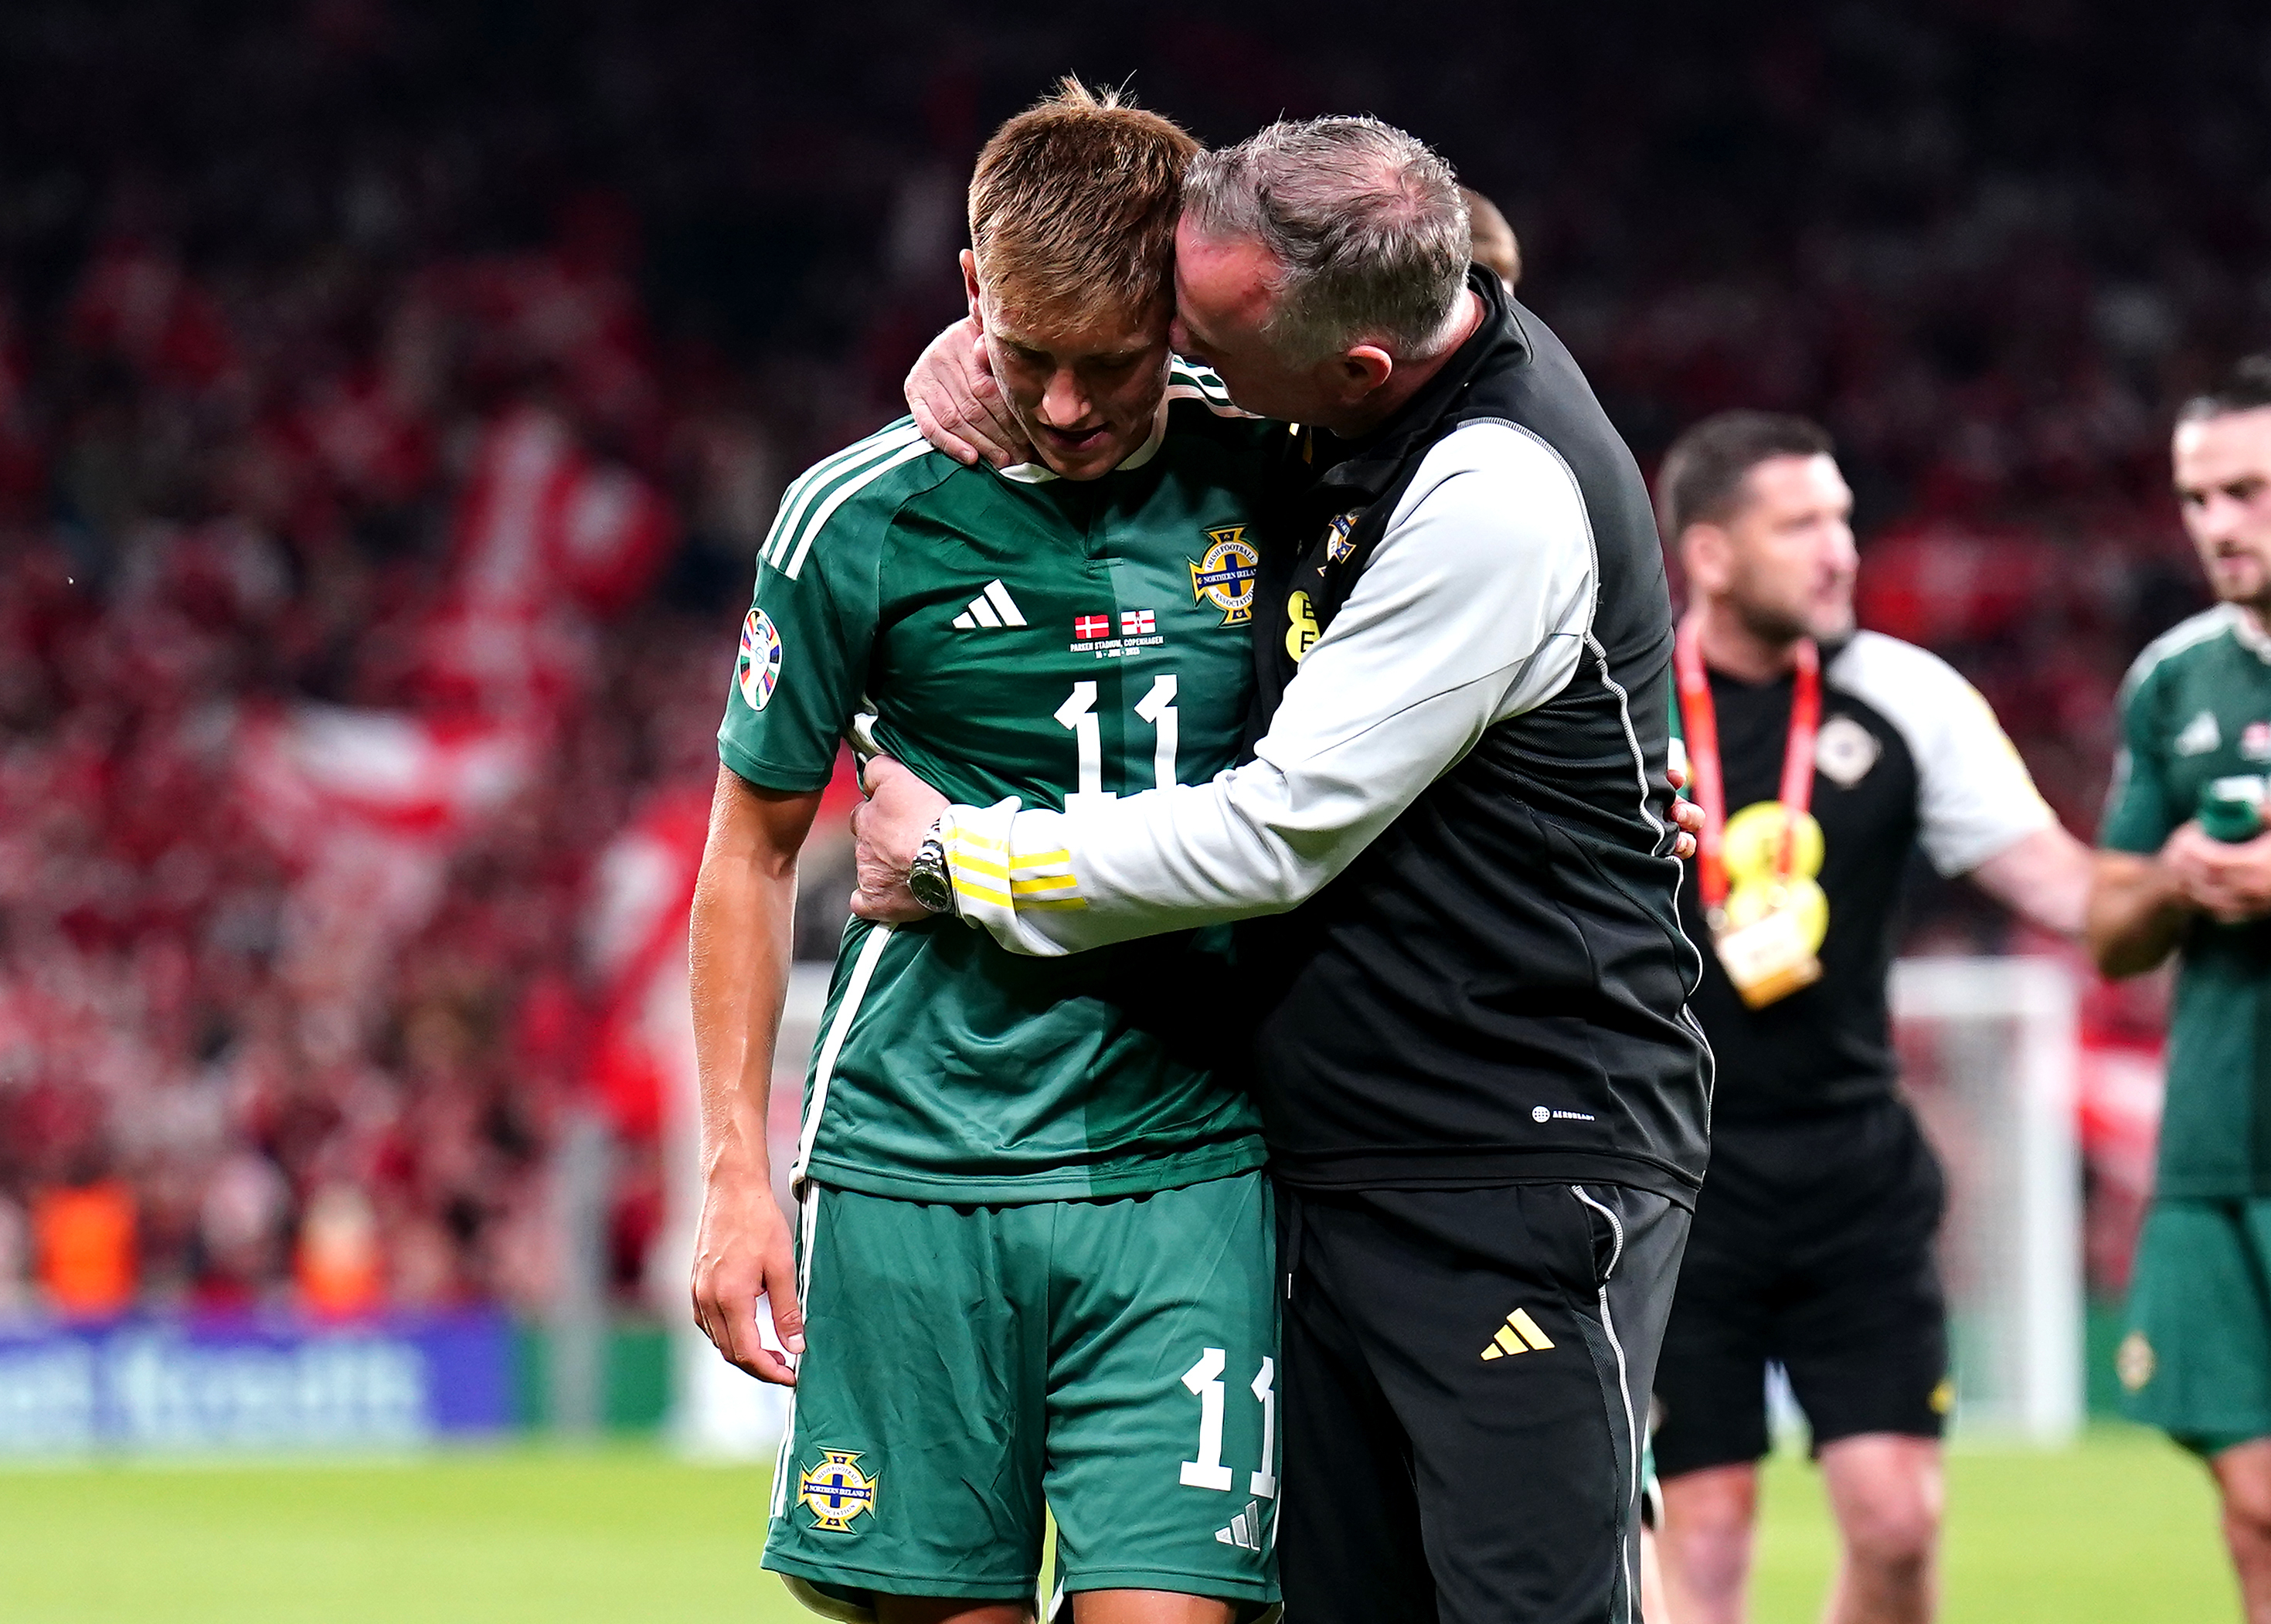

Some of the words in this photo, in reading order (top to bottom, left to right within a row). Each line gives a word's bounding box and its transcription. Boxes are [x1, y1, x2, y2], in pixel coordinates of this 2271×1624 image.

[1207, 548, 1222, 569] IRISH
[1221, 544, 1254, 562] FOOTBALL
[1203, 572, 1236, 583] NORTHERN
[1236, 569, 1256, 579] IRELA
[1070, 642, 1093, 652] PARKEN
[1094, 640, 1123, 650] STADIUM,
[1124, 636, 1164, 647] COPENHAGEN
[1052, 674, 1178, 810] 11
[1179, 1347, 1275, 1499] 11
[815, 1467, 831, 1480] IRISH
[809, 1485, 839, 1494] NORTHERN
[839, 1488, 865, 1497] IRELAND
[814, 1500, 856, 1516] ASSOCIATION
